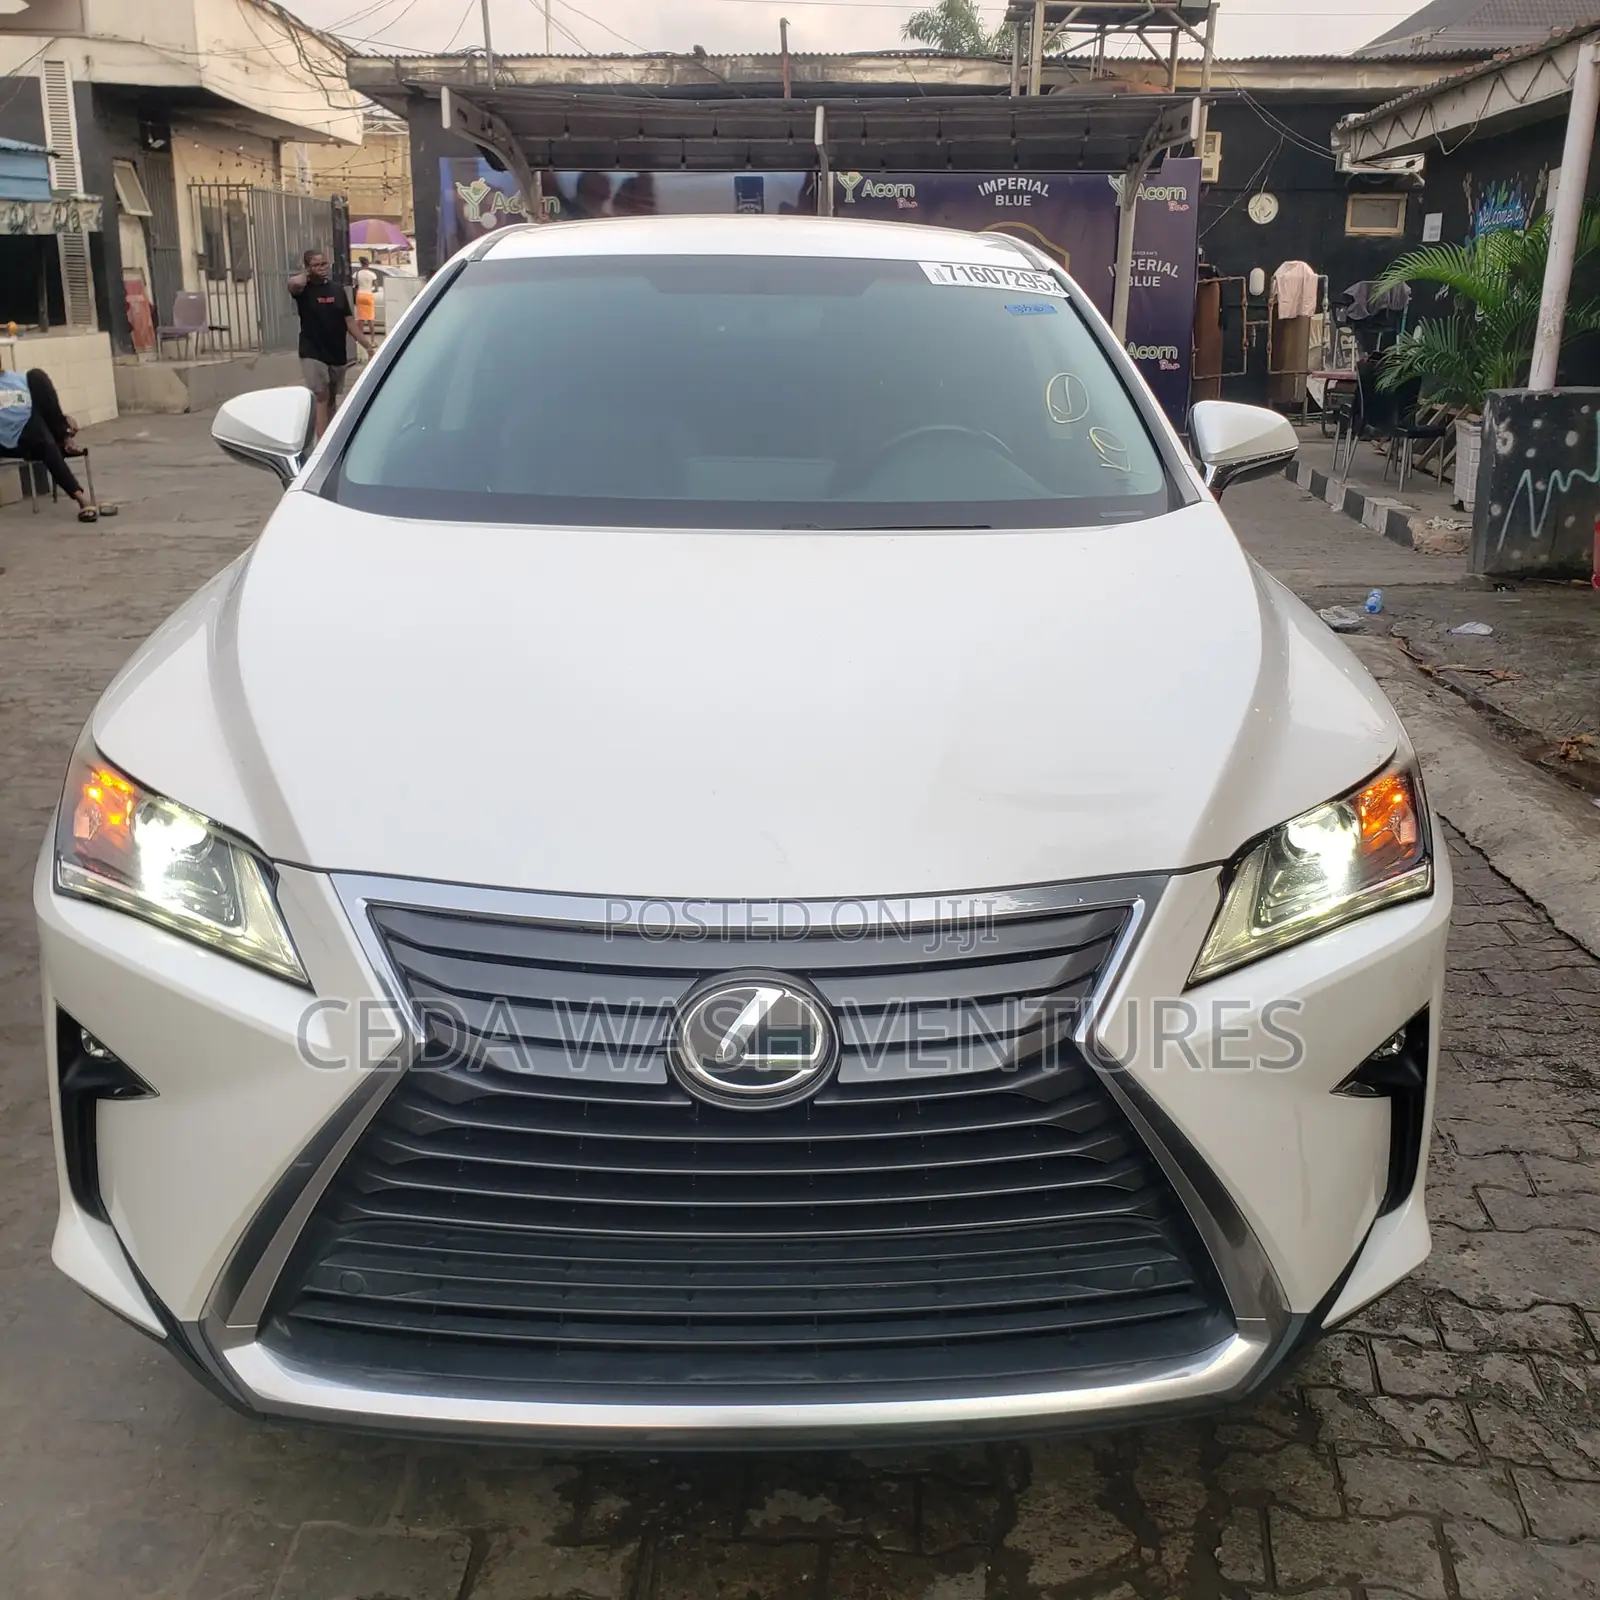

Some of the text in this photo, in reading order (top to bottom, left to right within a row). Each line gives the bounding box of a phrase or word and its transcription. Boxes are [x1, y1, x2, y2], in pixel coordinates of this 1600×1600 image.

[861, 179, 915, 198] Acorn
[977, 177, 1050, 197] IMPERIAL
[995, 195, 1032, 206] BLUE
[940, 264, 1051, 292] 71607295
[1107, 258, 1179, 279] IPERIAL
[1126, 341, 1178, 359] Acorn
